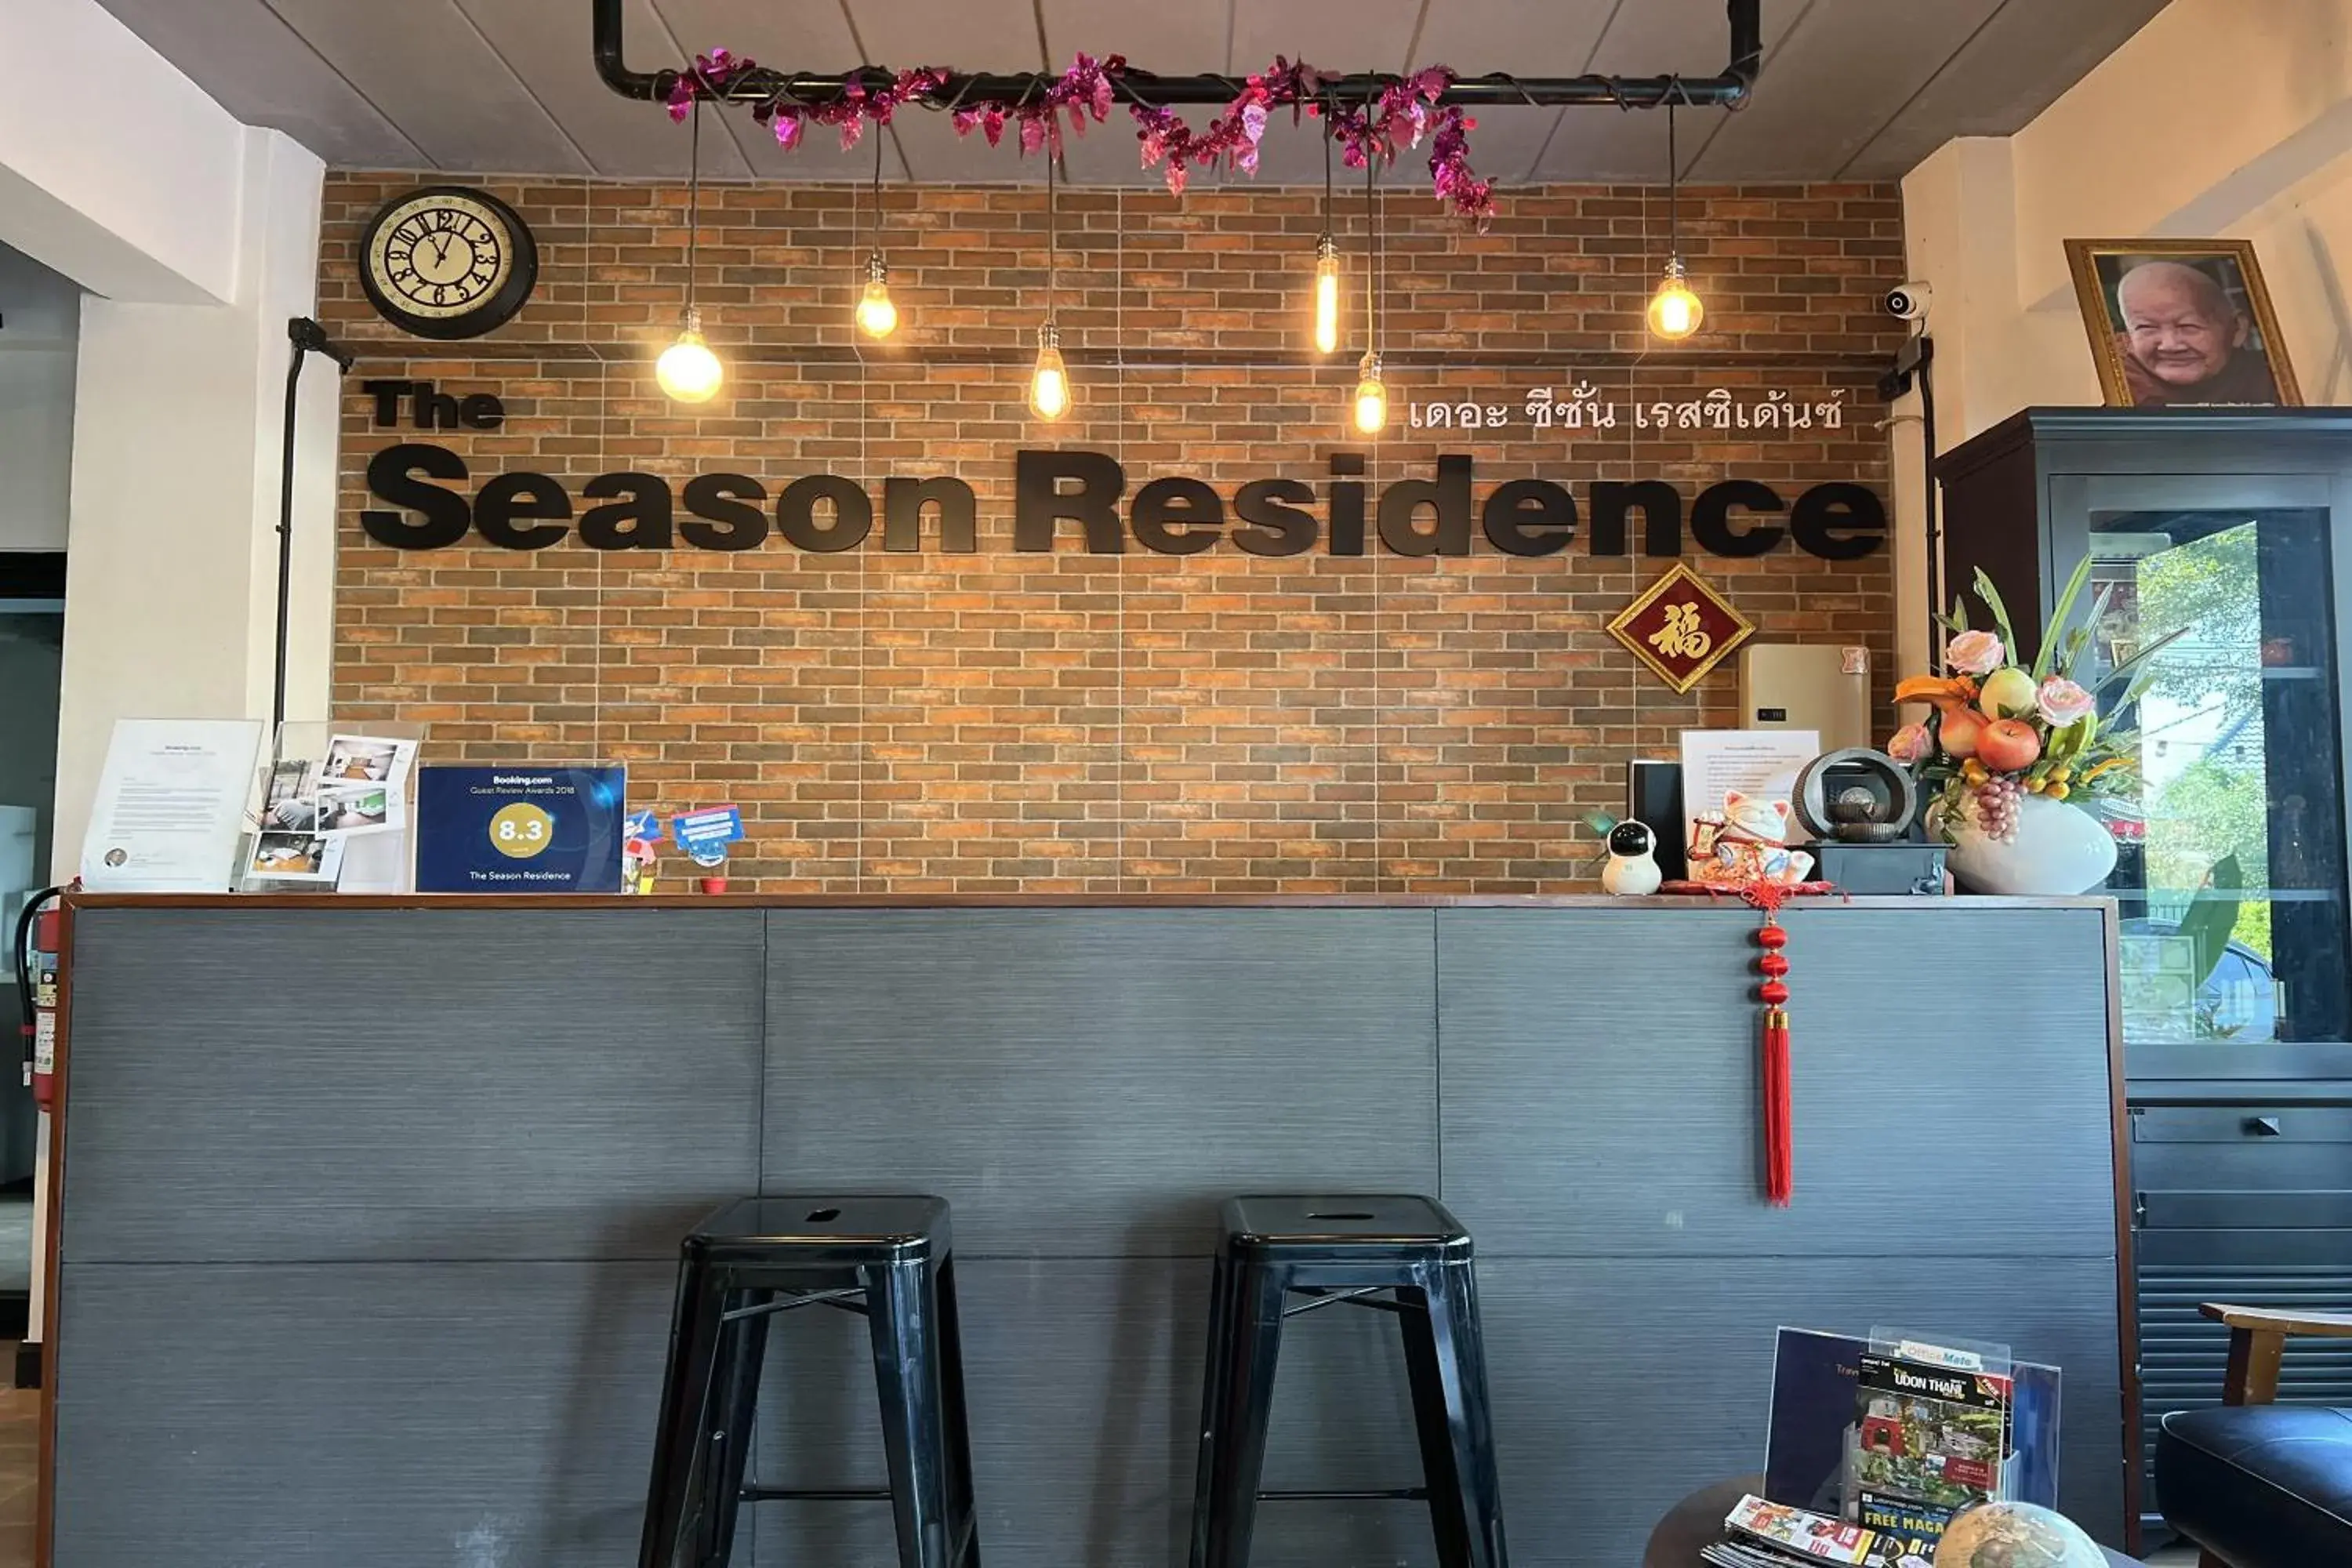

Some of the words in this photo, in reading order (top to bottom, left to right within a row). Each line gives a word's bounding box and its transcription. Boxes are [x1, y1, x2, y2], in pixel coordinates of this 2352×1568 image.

[416, 214, 431, 233] 11
[437, 210, 452, 230] 12
[461, 219, 473, 234] 1
[394, 228, 417, 245] 10
[471, 233, 492, 248] 2
[388, 251, 408, 260] 9
[476, 254, 497, 264] 3
[394, 268, 412, 281] 8
[471, 271, 490, 285] 4
[410, 278, 427, 297] 7
[434, 286, 444, 304] 6
[455, 283, 470, 299] 5
[364, 380, 504, 429] The
[1410, 401, 1508, 428] เดอะ
[1525, 380, 1616, 428] ซีซั่น
[1635, 388, 1846, 429] เรสซิเด้นซ์
[360, 444, 976, 553] Season
[1014, 449, 1886, 558] Residence
[1648, 601, 1711, 659] 福
[493, 775, 553, 786] Booking.com
[499, 820, 543, 840] 8.3
[470, 871, 487, 880] The
[488, 871, 521, 880] Season
[523, 871, 572, 880] Residence
[1894, 1373, 1926, 1390] UDON
[1864, 1512, 1898, 1528] FREE
